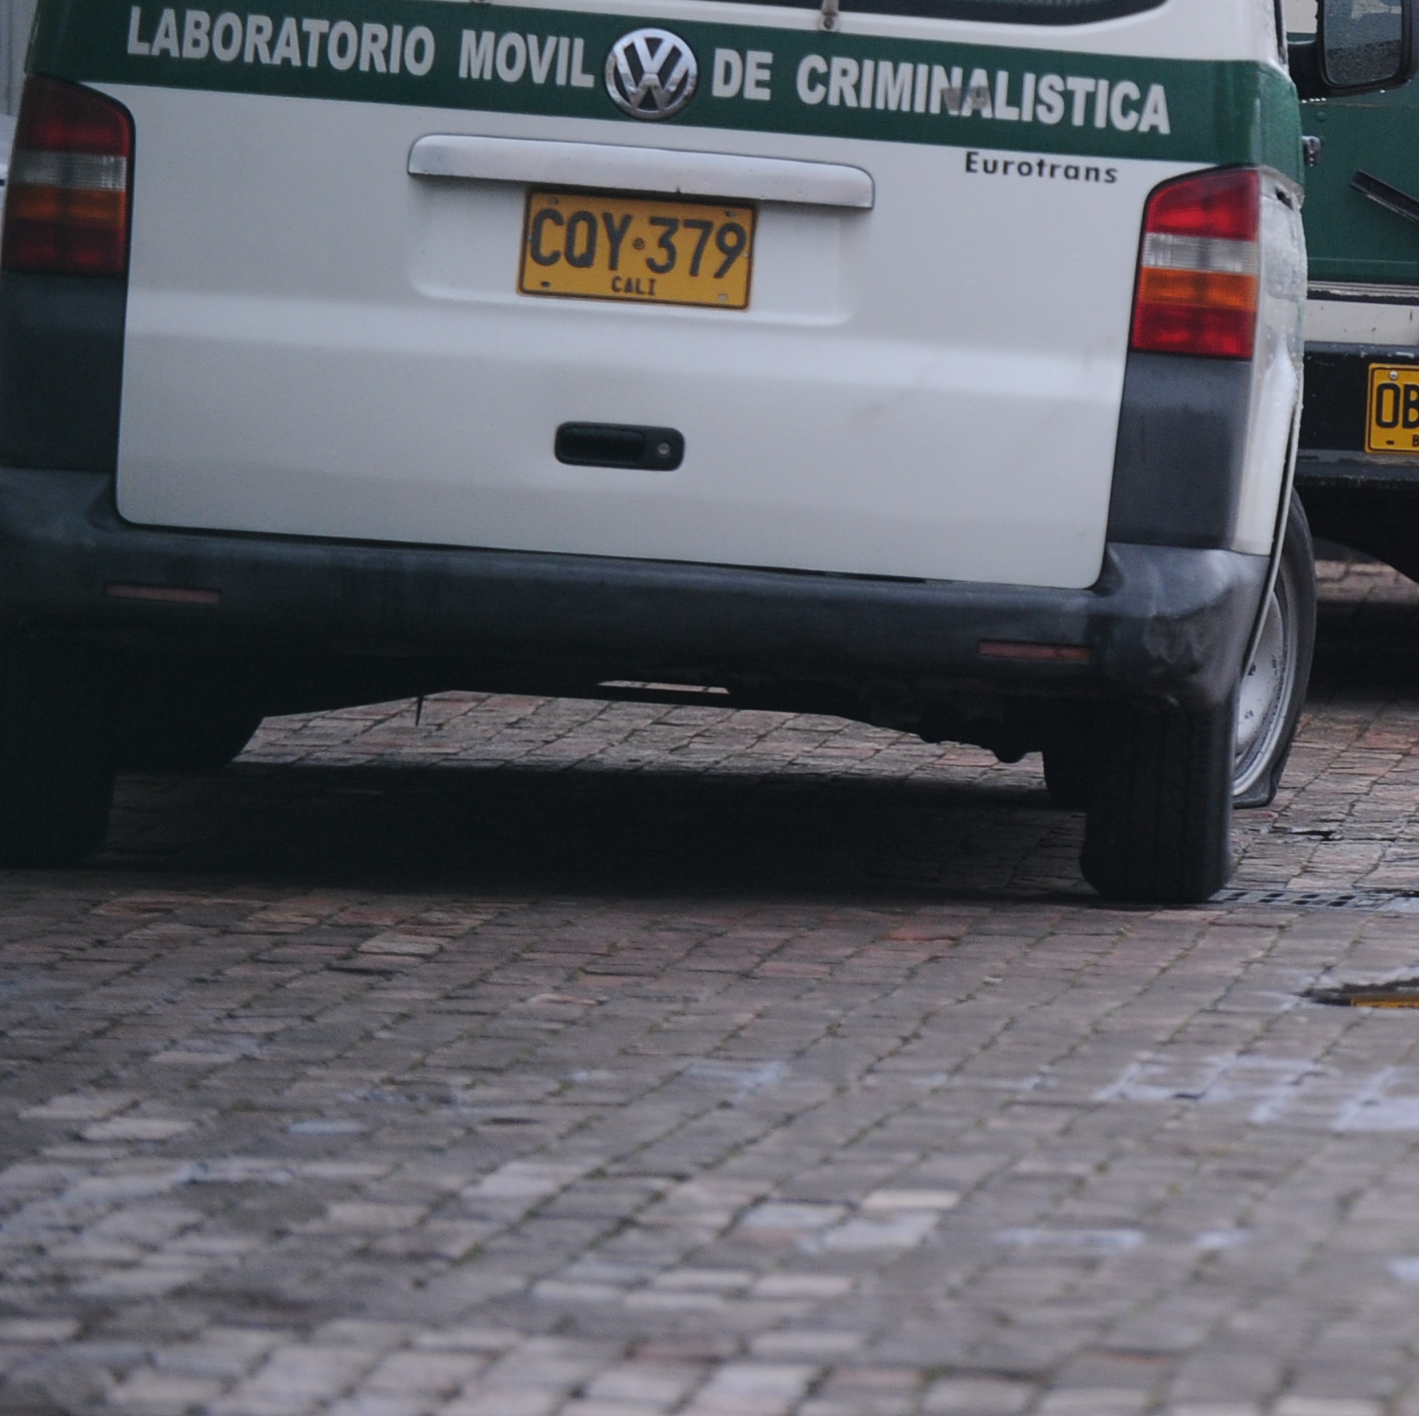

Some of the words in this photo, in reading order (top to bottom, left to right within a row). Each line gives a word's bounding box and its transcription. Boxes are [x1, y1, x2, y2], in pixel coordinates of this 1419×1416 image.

[127, 5, 436, 77] LABORATORIO
[458, 29, 595, 88] MOVIL
[711, 47, 774, 102] DE
[795, 54, 1172, 135] CRIMINALISTICA
[965, 150, 1118, 185] Eurotrans
[611, 275, 657, 296] CALI
